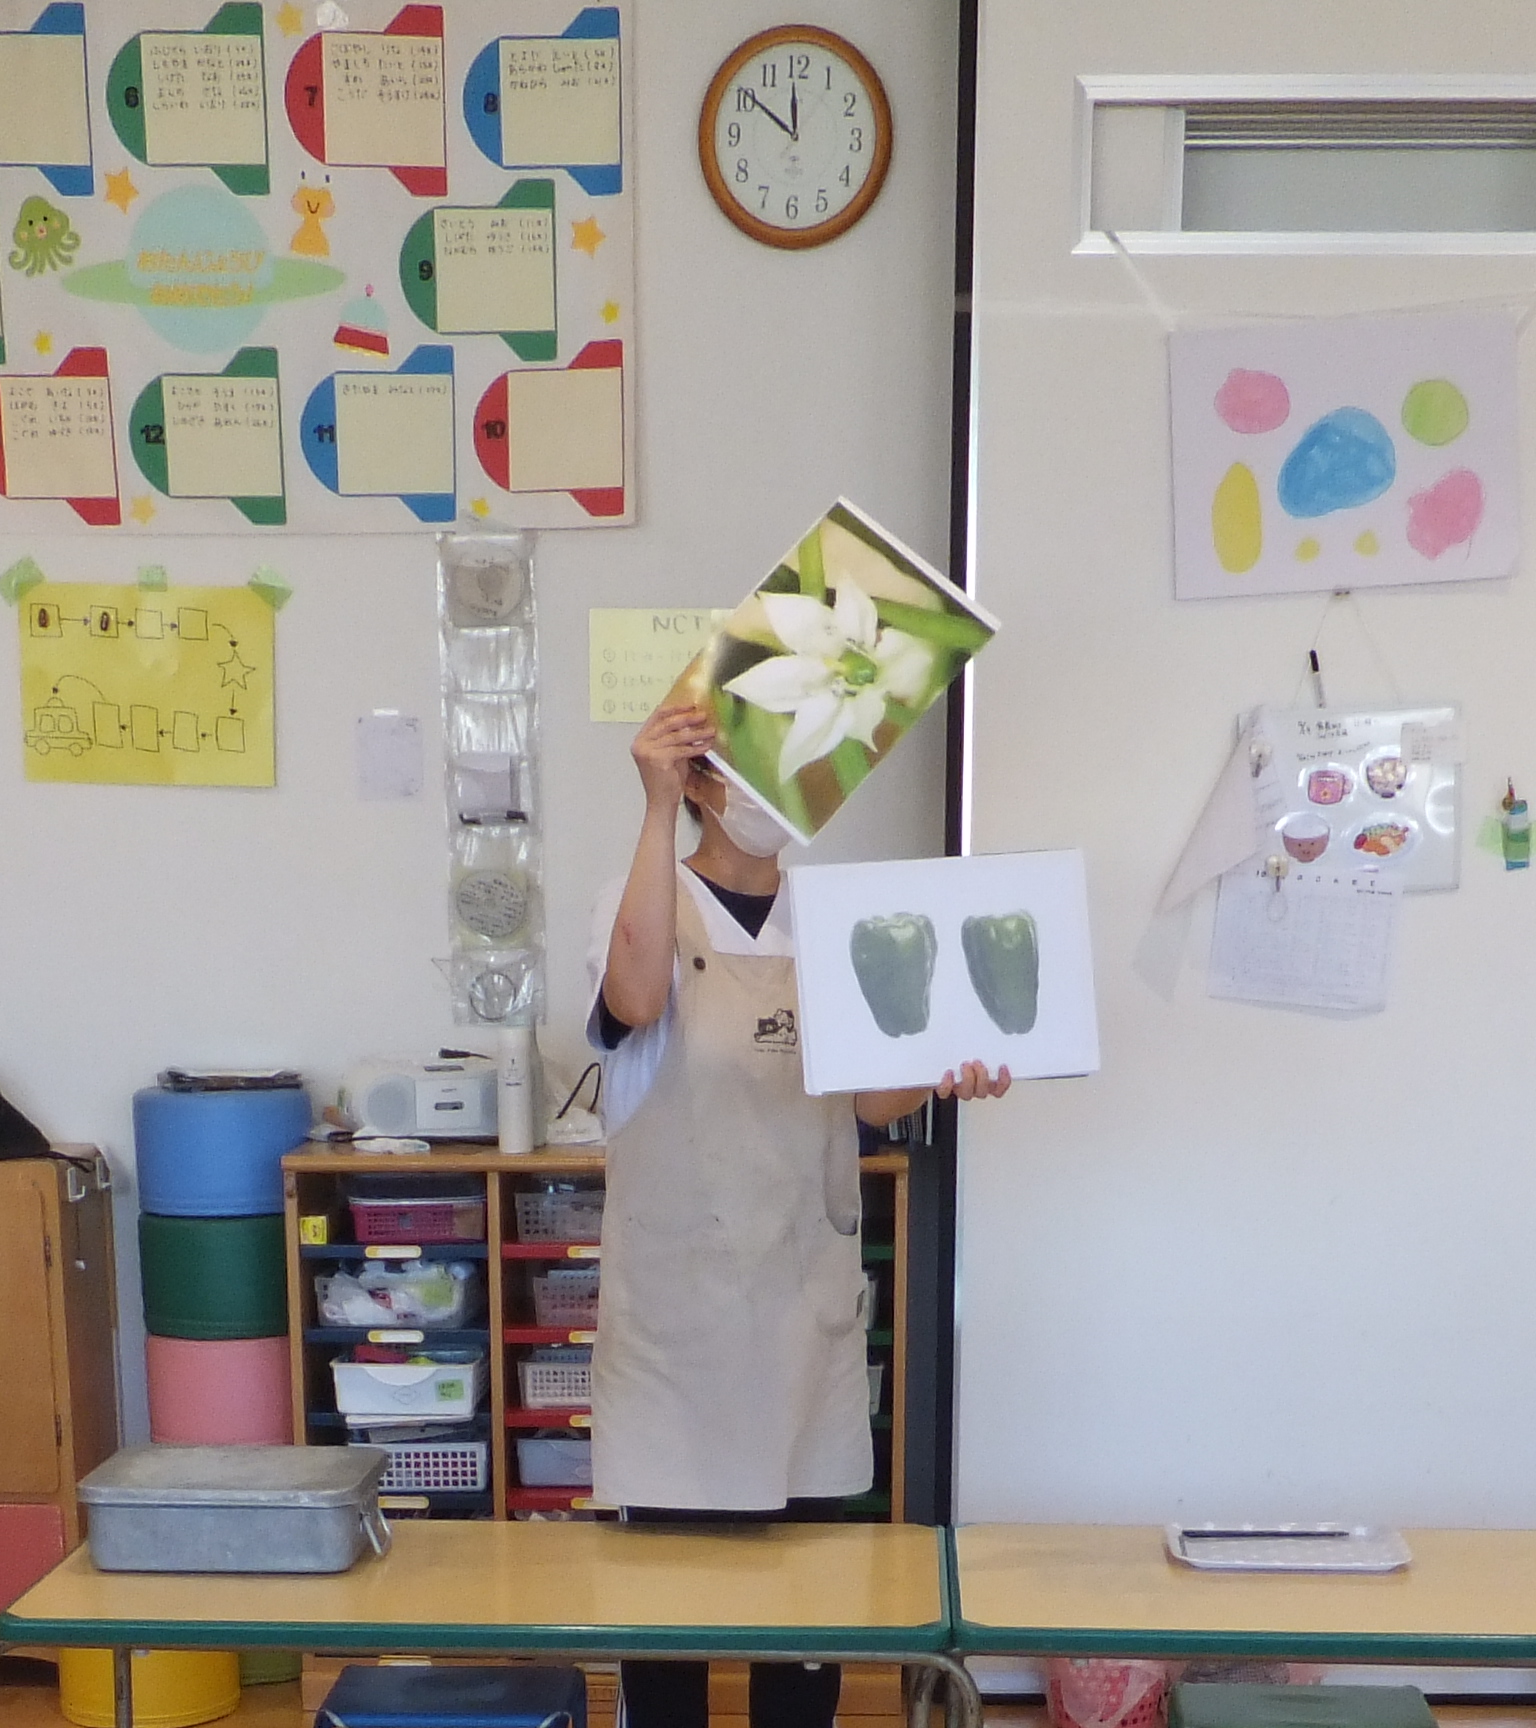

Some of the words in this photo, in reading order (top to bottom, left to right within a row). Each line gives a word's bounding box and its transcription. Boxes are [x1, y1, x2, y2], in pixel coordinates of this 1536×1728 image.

[762, 64, 776, 87] 11
[788, 55, 810, 79] 12
[825, 66, 831, 90] 1
[125, 87, 139, 108] 6
[304, 86, 317, 106] 7
[484, 92, 498, 113] 8
[736, 88, 756, 112] 10
[844, 93, 856, 117] 2
[728, 122, 741, 147] 9
[850, 128, 862, 152] 3
[736, 159, 748, 183] 8
[839, 165, 850, 187] 4
[759, 186, 769, 209] 7
[786, 195, 798, 219] 6
[816, 190, 828, 212] 5
[418, 260, 433, 281] 9
[140, 424, 164, 444] 12
[318, 424, 336, 442] 11
[484, 421, 505, 440] 10
